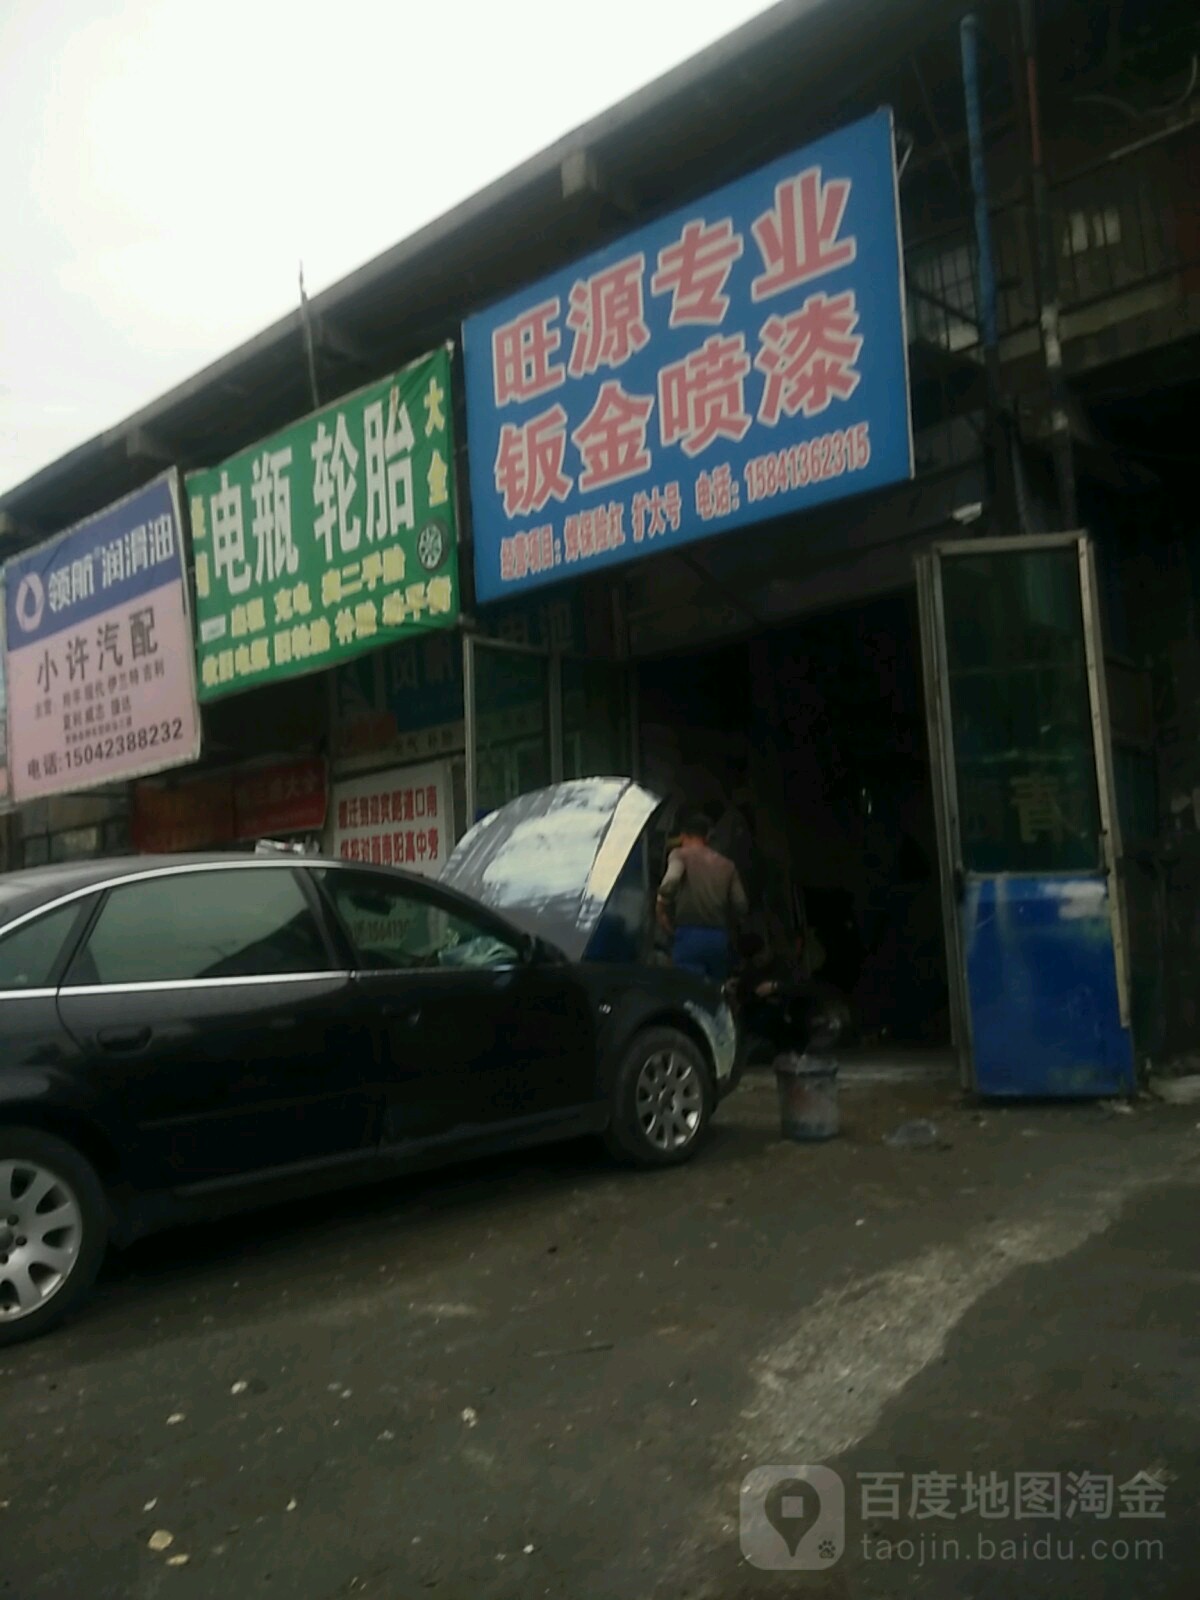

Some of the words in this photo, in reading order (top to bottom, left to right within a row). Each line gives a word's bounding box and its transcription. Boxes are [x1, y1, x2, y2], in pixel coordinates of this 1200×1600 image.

[492, 164, 857, 407] 旺源专业
[209, 445, 300, 595] 电瓶
[310, 384, 416, 562] 轮胎
[494, 289, 864, 518] 钣金喷漆
[36, 605, 159, 694] 小许汽配
